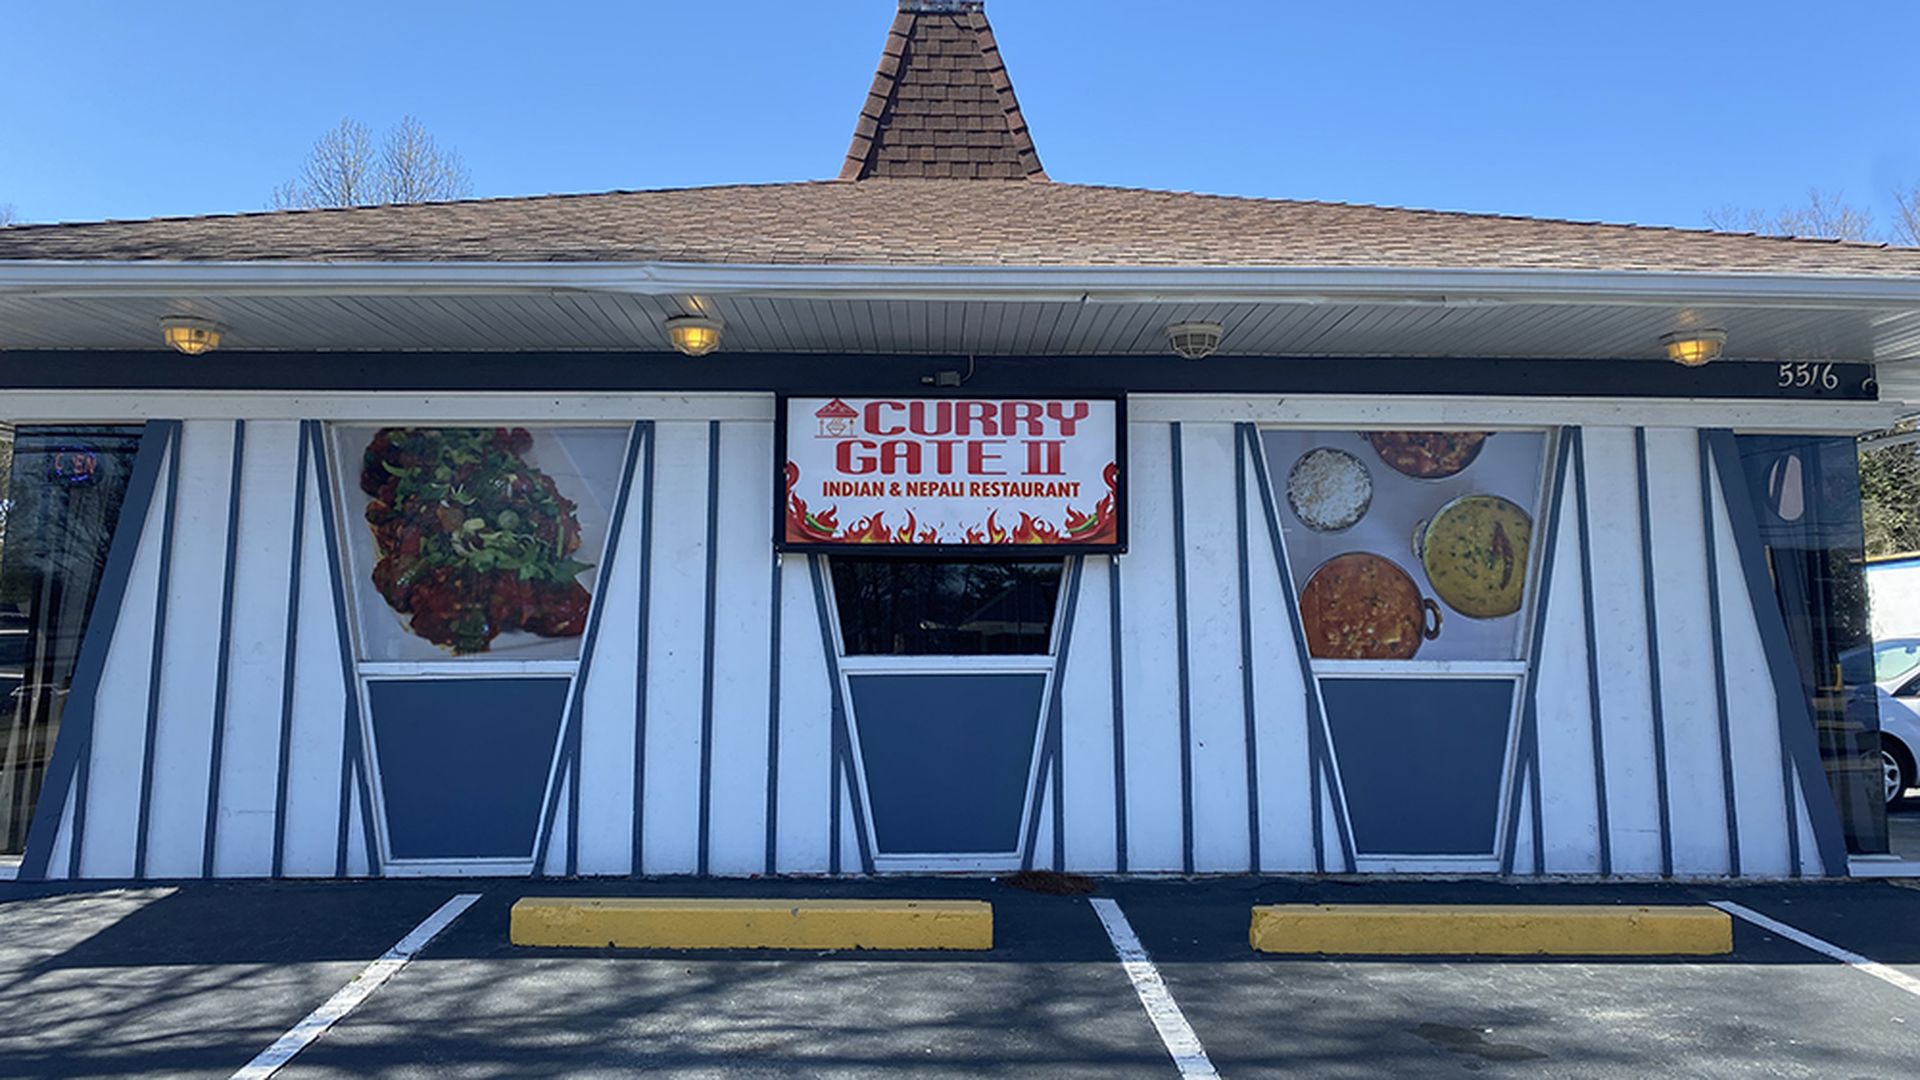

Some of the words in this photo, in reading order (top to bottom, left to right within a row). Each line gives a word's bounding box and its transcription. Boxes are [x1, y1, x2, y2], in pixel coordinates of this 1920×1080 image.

[1778, 362, 1838, 390] 5516
[864, 402, 1089, 436] CURRY
[836, 440, 1007, 475] GATE
[1021, 440, 1067, 475] II
[822, 481, 886, 498] INDIAN
[889, 481, 902, 498] &
[906, 481, 965, 498] NEPALI
[970, 481, 1081, 498] RESTAURANT
